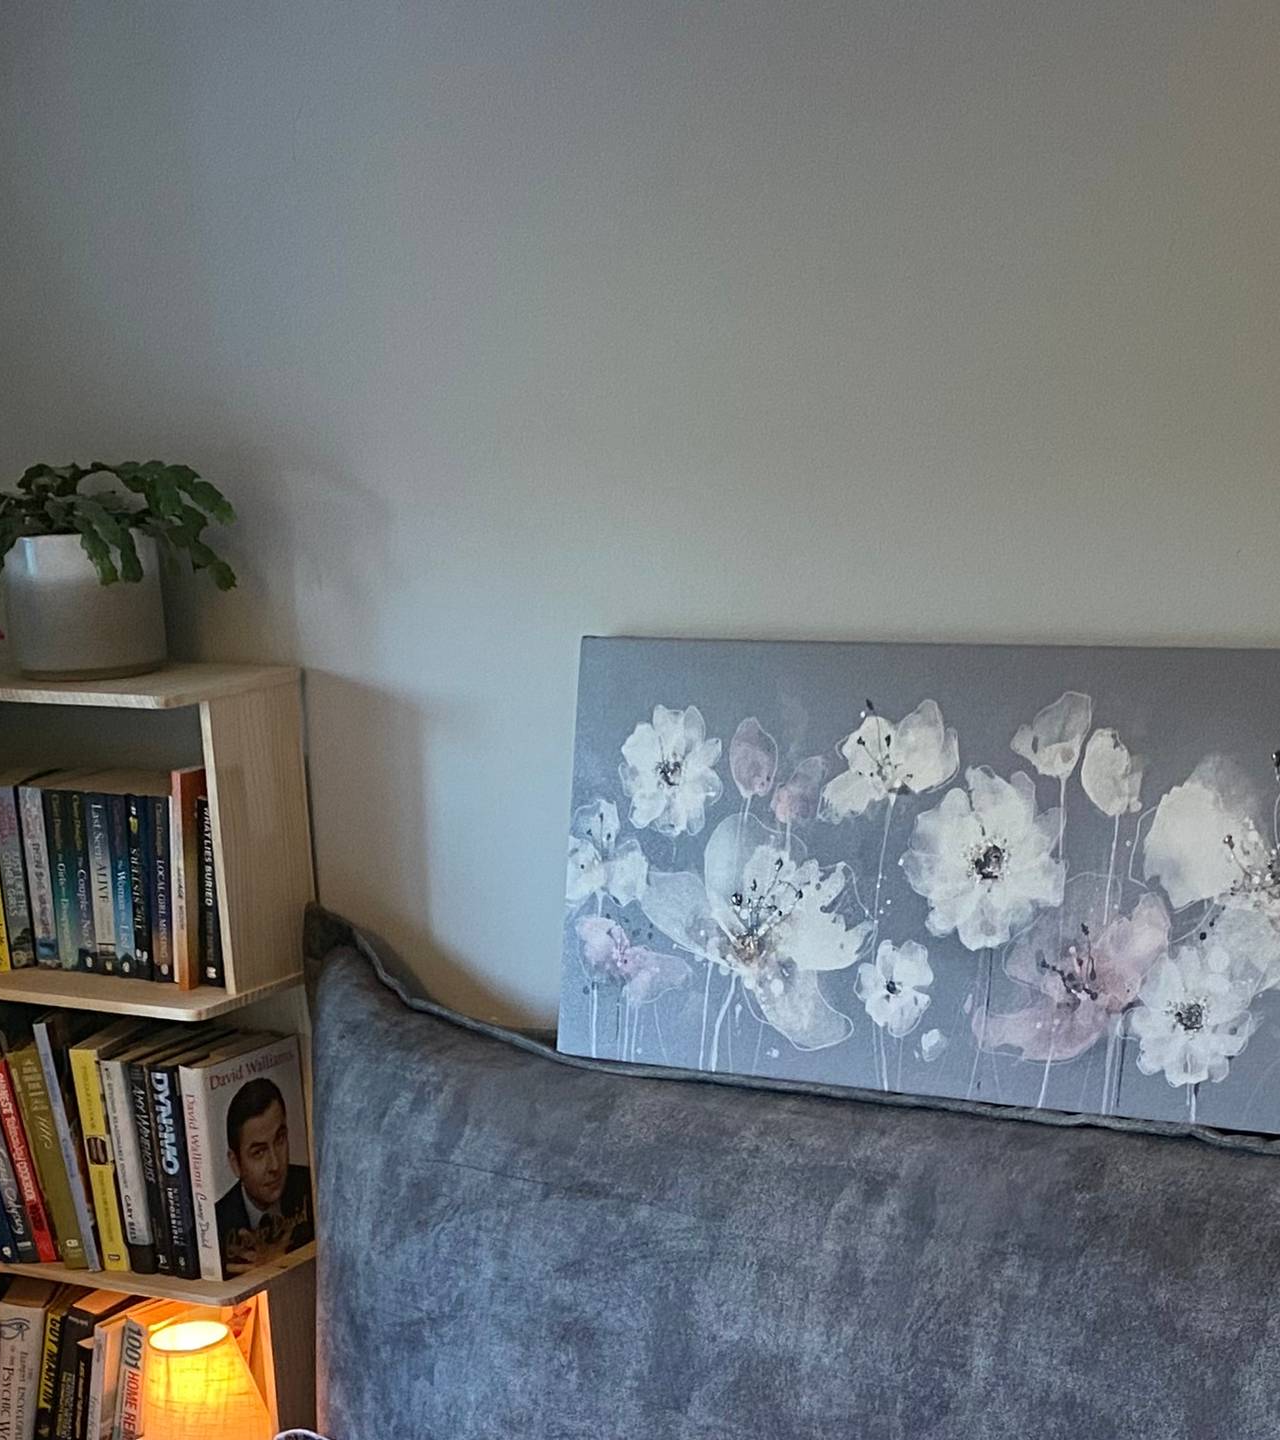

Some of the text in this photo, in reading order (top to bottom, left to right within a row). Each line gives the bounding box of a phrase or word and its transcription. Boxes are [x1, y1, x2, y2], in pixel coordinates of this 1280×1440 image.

[91, 804, 104, 830] Last
[93, 832, 105, 864] Seen
[204, 839, 212, 863] LIES
[77, 868, 89, 910] Couple
[96, 865, 109, 903] ALIVE
[116, 871, 126, 910] Woman
[156, 860, 166, 890] LOCAL
[205, 865, 213, 907] BURIED
[209, 1049, 296, 1091] David Walliams
[151, 1071, 180, 1176] DYNAMO
[186, 1094, 199, 1132] David
[132, 1085, 157, 1184] AMY WINEHOUSE
[190, 1134, 202, 1190] Walliams
[167, 1187, 180, 1245] IMPOSSIBLE
[43, 1316, 62, 1409] GUY MARTIN
[124, 1326, 143, 1372] 1001
[0, 1367, 15, 1418] PSYCHIC
[124, 1371, 140, 1413] HOME
